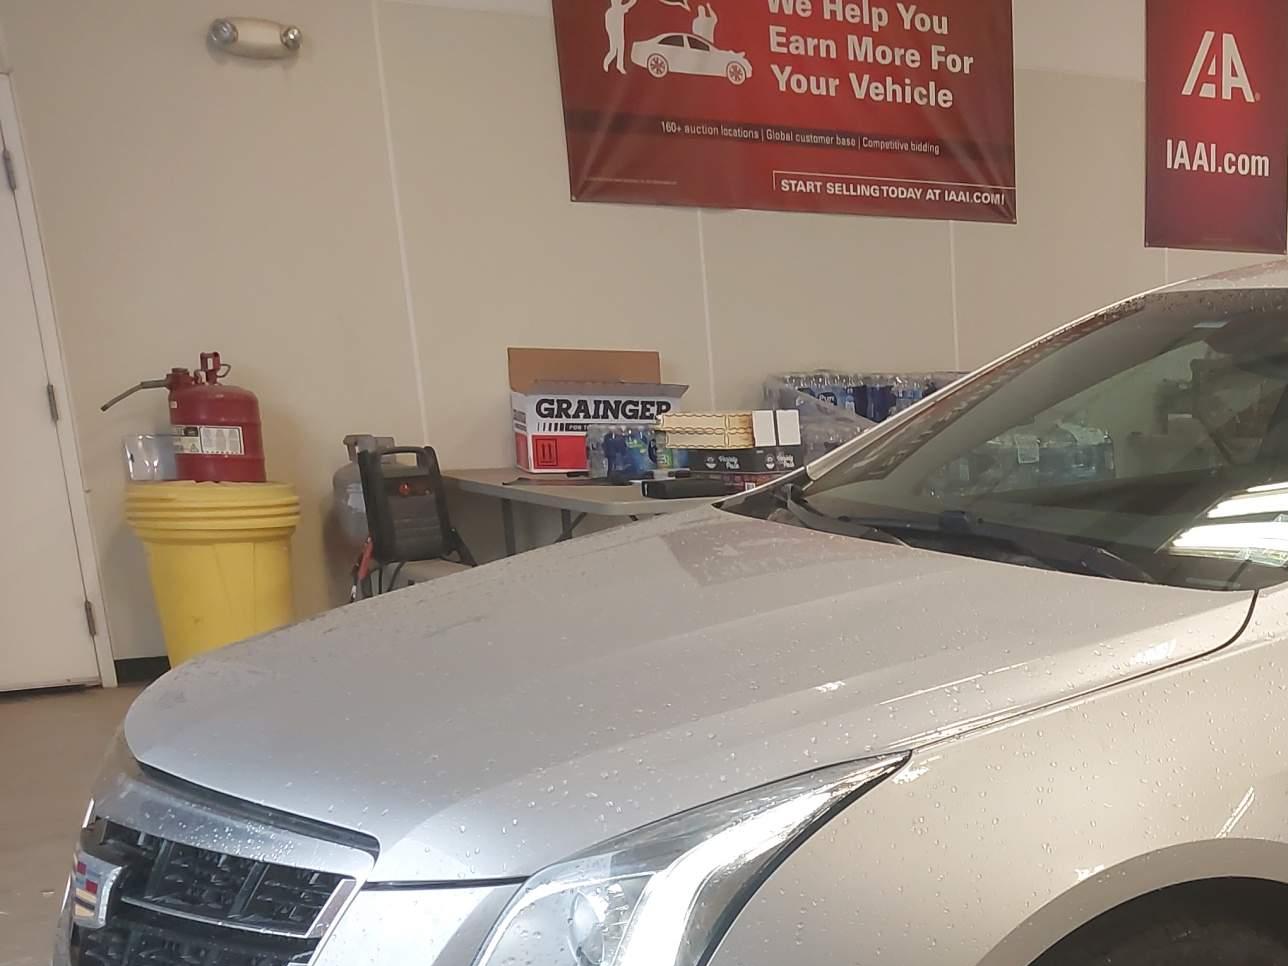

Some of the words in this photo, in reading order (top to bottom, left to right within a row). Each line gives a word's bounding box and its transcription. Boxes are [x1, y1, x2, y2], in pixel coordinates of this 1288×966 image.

[823, 0, 889, 32] Help
[896, 3, 949, 35] You
[769, 25, 837, 59] Earn
[847, 34, 921, 68] More
[931, 44, 974, 74] For
[770, 63, 840, 97] Your
[849, 72, 953, 109] Vehicle
[661, 121, 682, 134] 160+
[684, 124, 719, 137] auction
[720, 125, 760, 140] locations
[766, 129, 794, 143] Global
[795, 132, 834, 146] customer
[836, 135, 856, 147] base
[862, 136, 909, 152] Competitive
[910, 140, 940, 156] bidding
[1166, 138, 1270, 177] IAAI.com
[780, 178, 822, 194] START
[826, 182, 880, 197] SELLING
[880, 185, 922, 200] TODAY
[925, 189, 942, 202] AT
